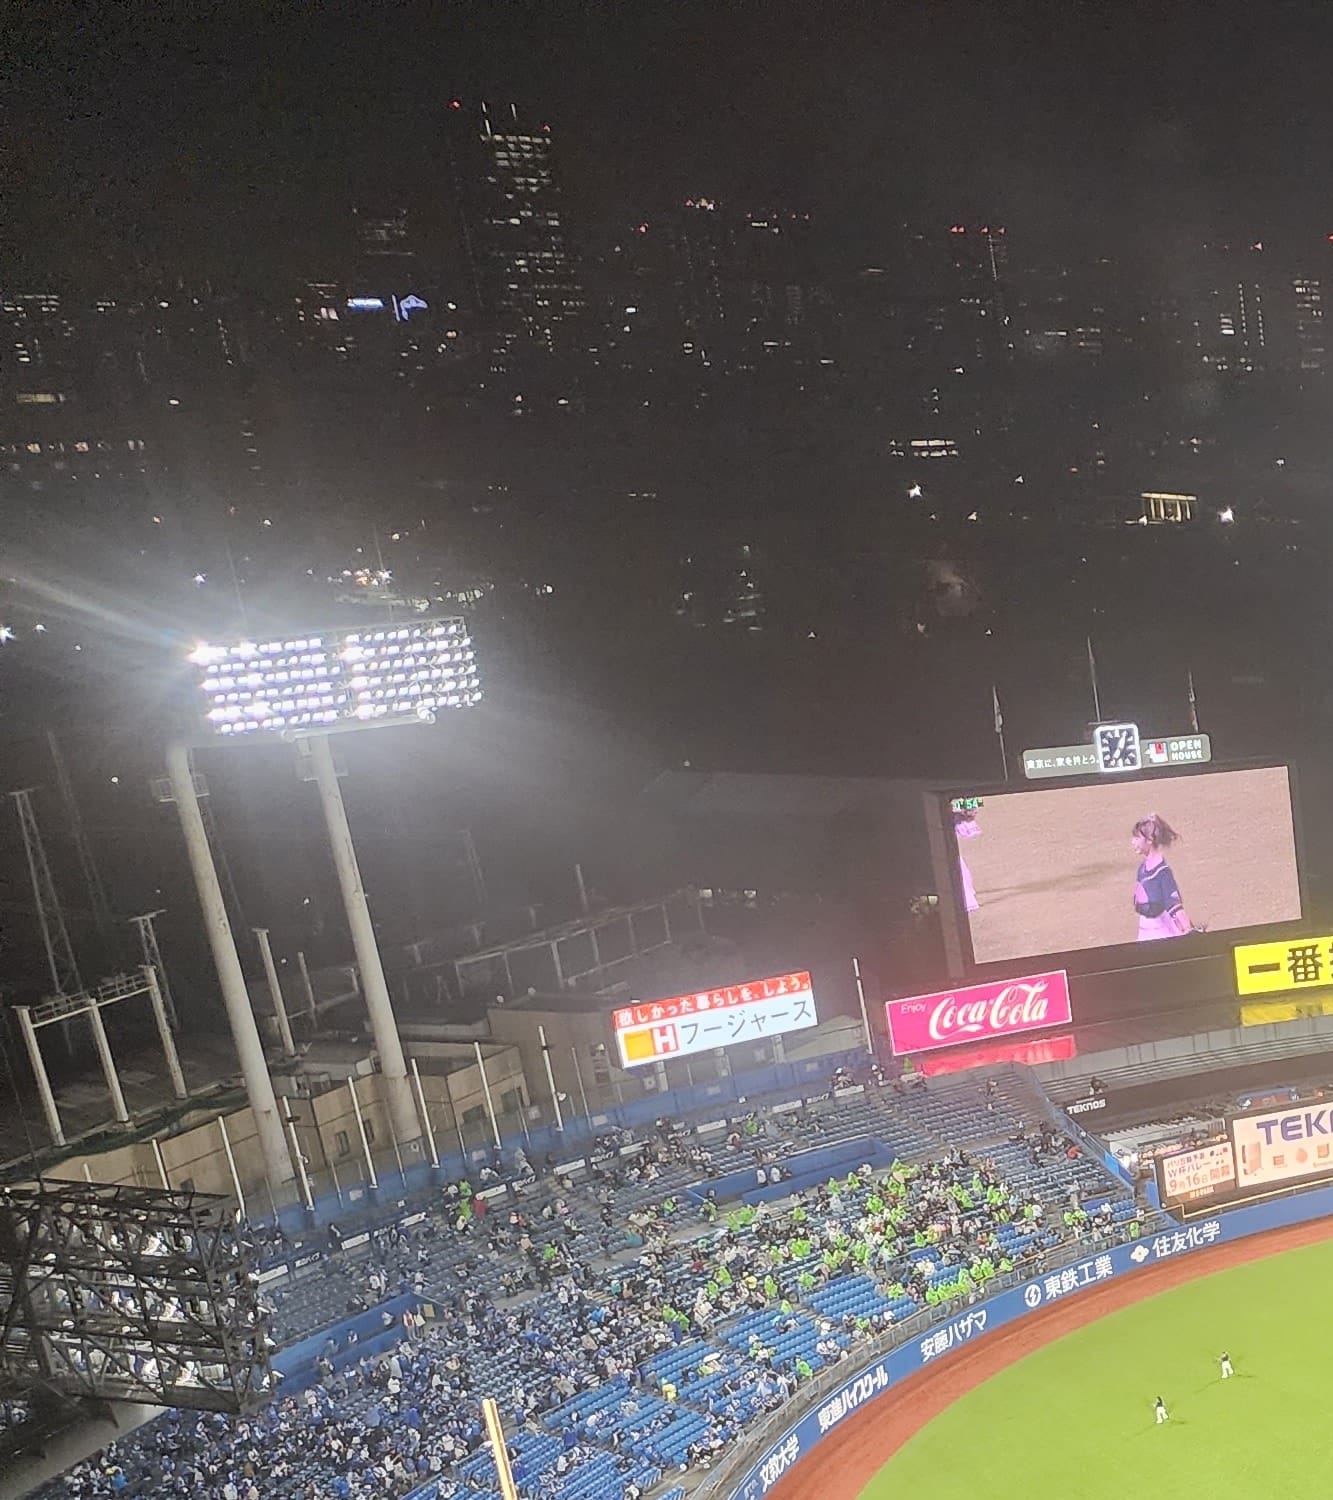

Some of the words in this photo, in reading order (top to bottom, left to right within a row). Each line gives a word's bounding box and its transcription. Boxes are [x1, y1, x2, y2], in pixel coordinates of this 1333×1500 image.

[1171, 740, 1201, 751] OPEN
[1172, 749, 1203, 761] HOUSE
[681, 999, 812, 1045] フージャース
[900, 1001, 927, 1015] Enjoy
[1066, 1098, 1106, 1115] TEKNOS
[1151, 1221, 1221, 1258] 住友化学
[1043, 1255, 1114, 1301] 東鉄工業
[920, 1309, 988, 1363] 安藤ハザマ
[816, 1364, 889, 1434] 東進ハイスクール
[760, 1433, 800, 1493] 文教大学
